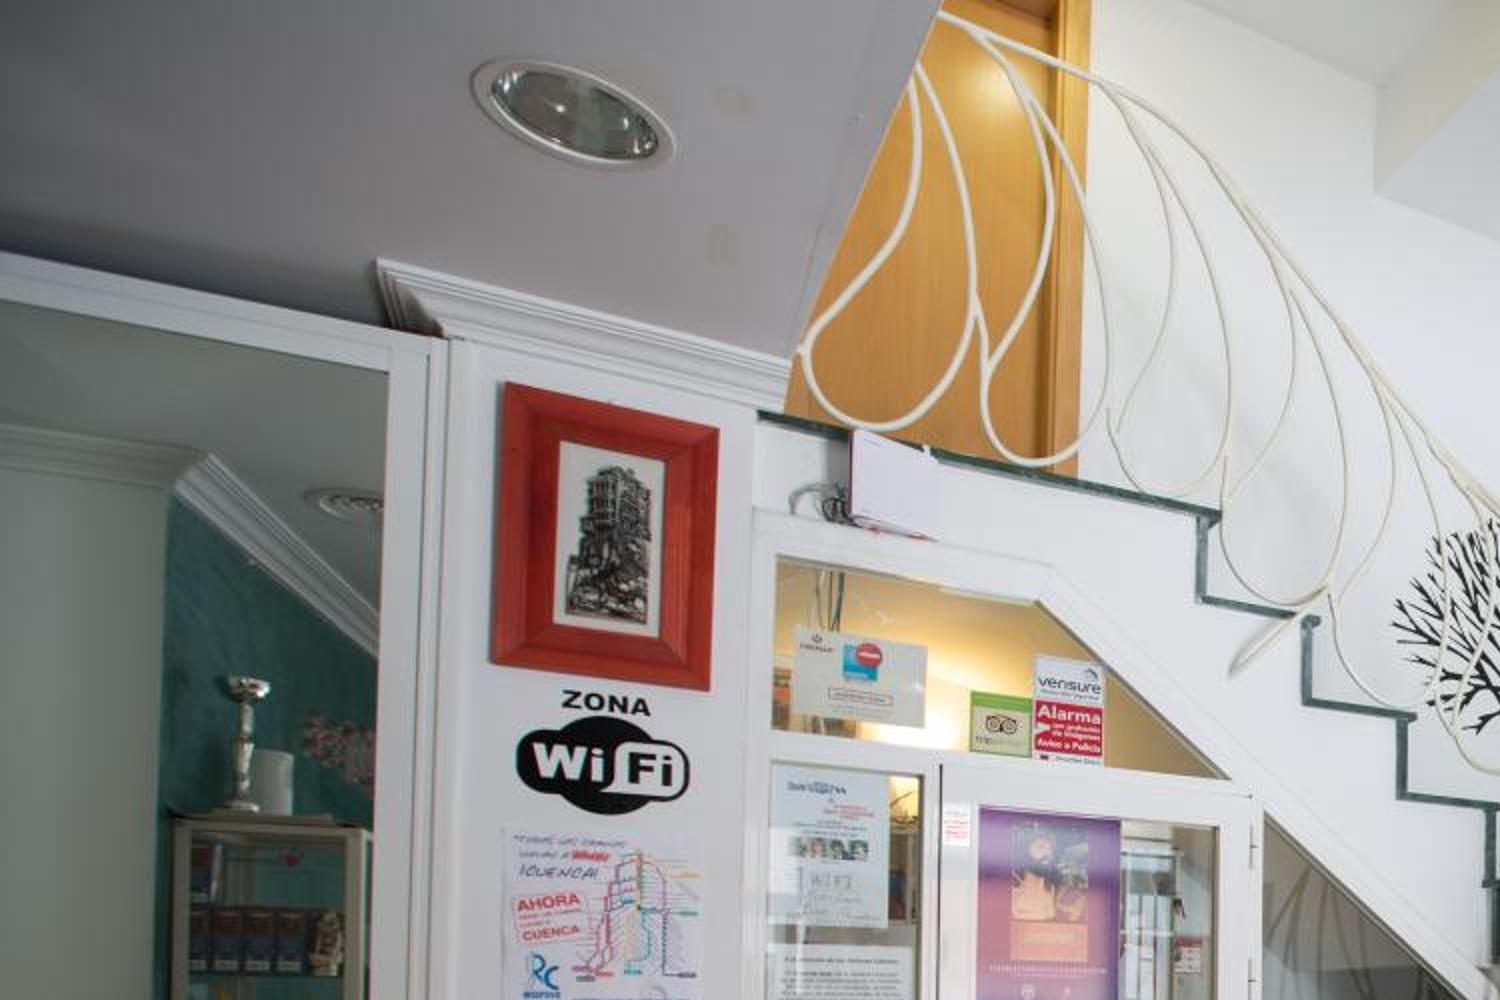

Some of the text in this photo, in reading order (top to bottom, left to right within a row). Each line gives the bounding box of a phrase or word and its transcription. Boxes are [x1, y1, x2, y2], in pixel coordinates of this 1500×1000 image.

[562, 689, 651, 716] ZONA
[1038, 703, 1101, 725] Alarma
[517, 893, 580, 912] AHORA
[521, 924, 580, 941] CUENCA
